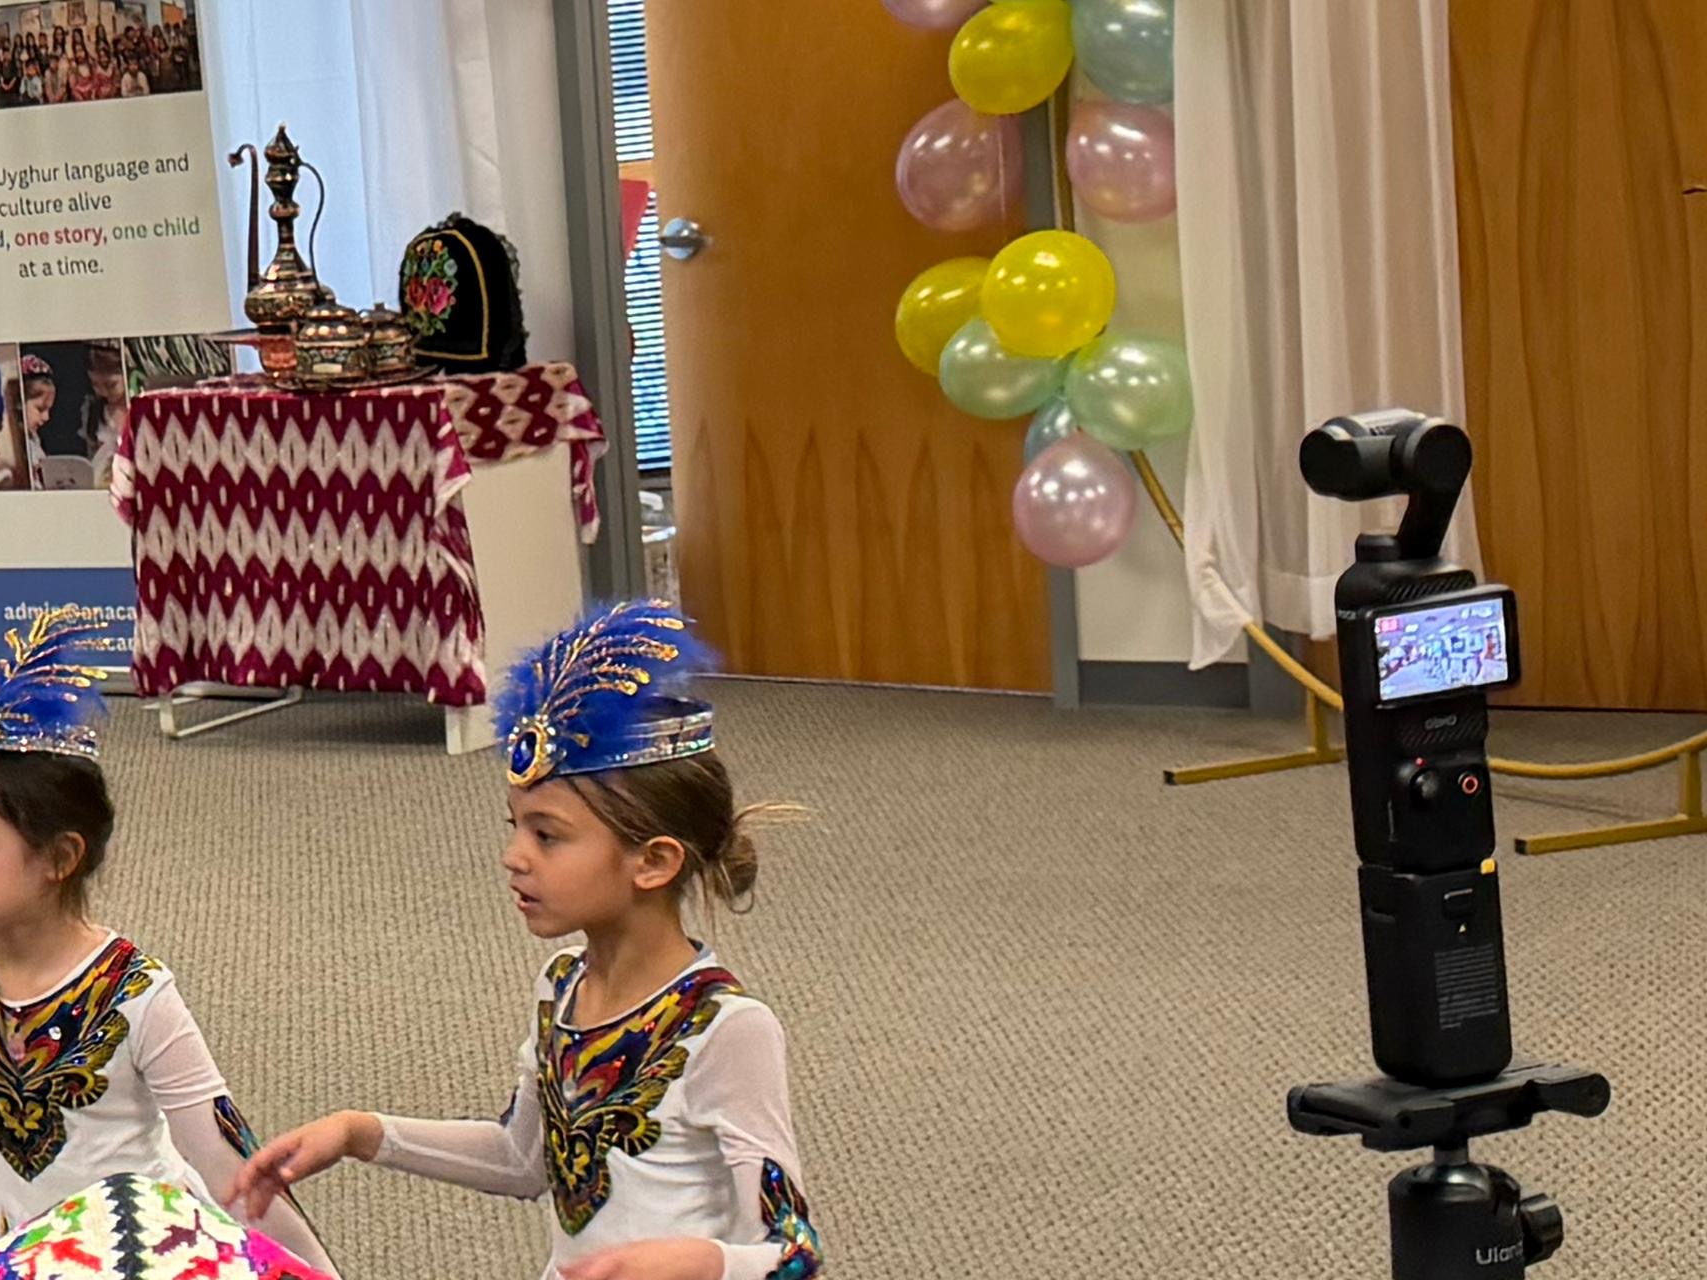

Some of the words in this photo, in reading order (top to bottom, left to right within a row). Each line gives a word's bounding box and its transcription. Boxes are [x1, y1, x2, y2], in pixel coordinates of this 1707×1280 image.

[64, 158, 150, 183] language
[155, 153, 190, 173] and
[68, 192, 112, 212] alive
[14, 229, 50, 247] one
[54, 226, 108, 246] story,
[112, 222, 148, 240] one
[153, 216, 201, 238] child
[19, 260, 37, 279] at
[42, 262, 53, 276] a
[56, 256, 104, 275] time.
